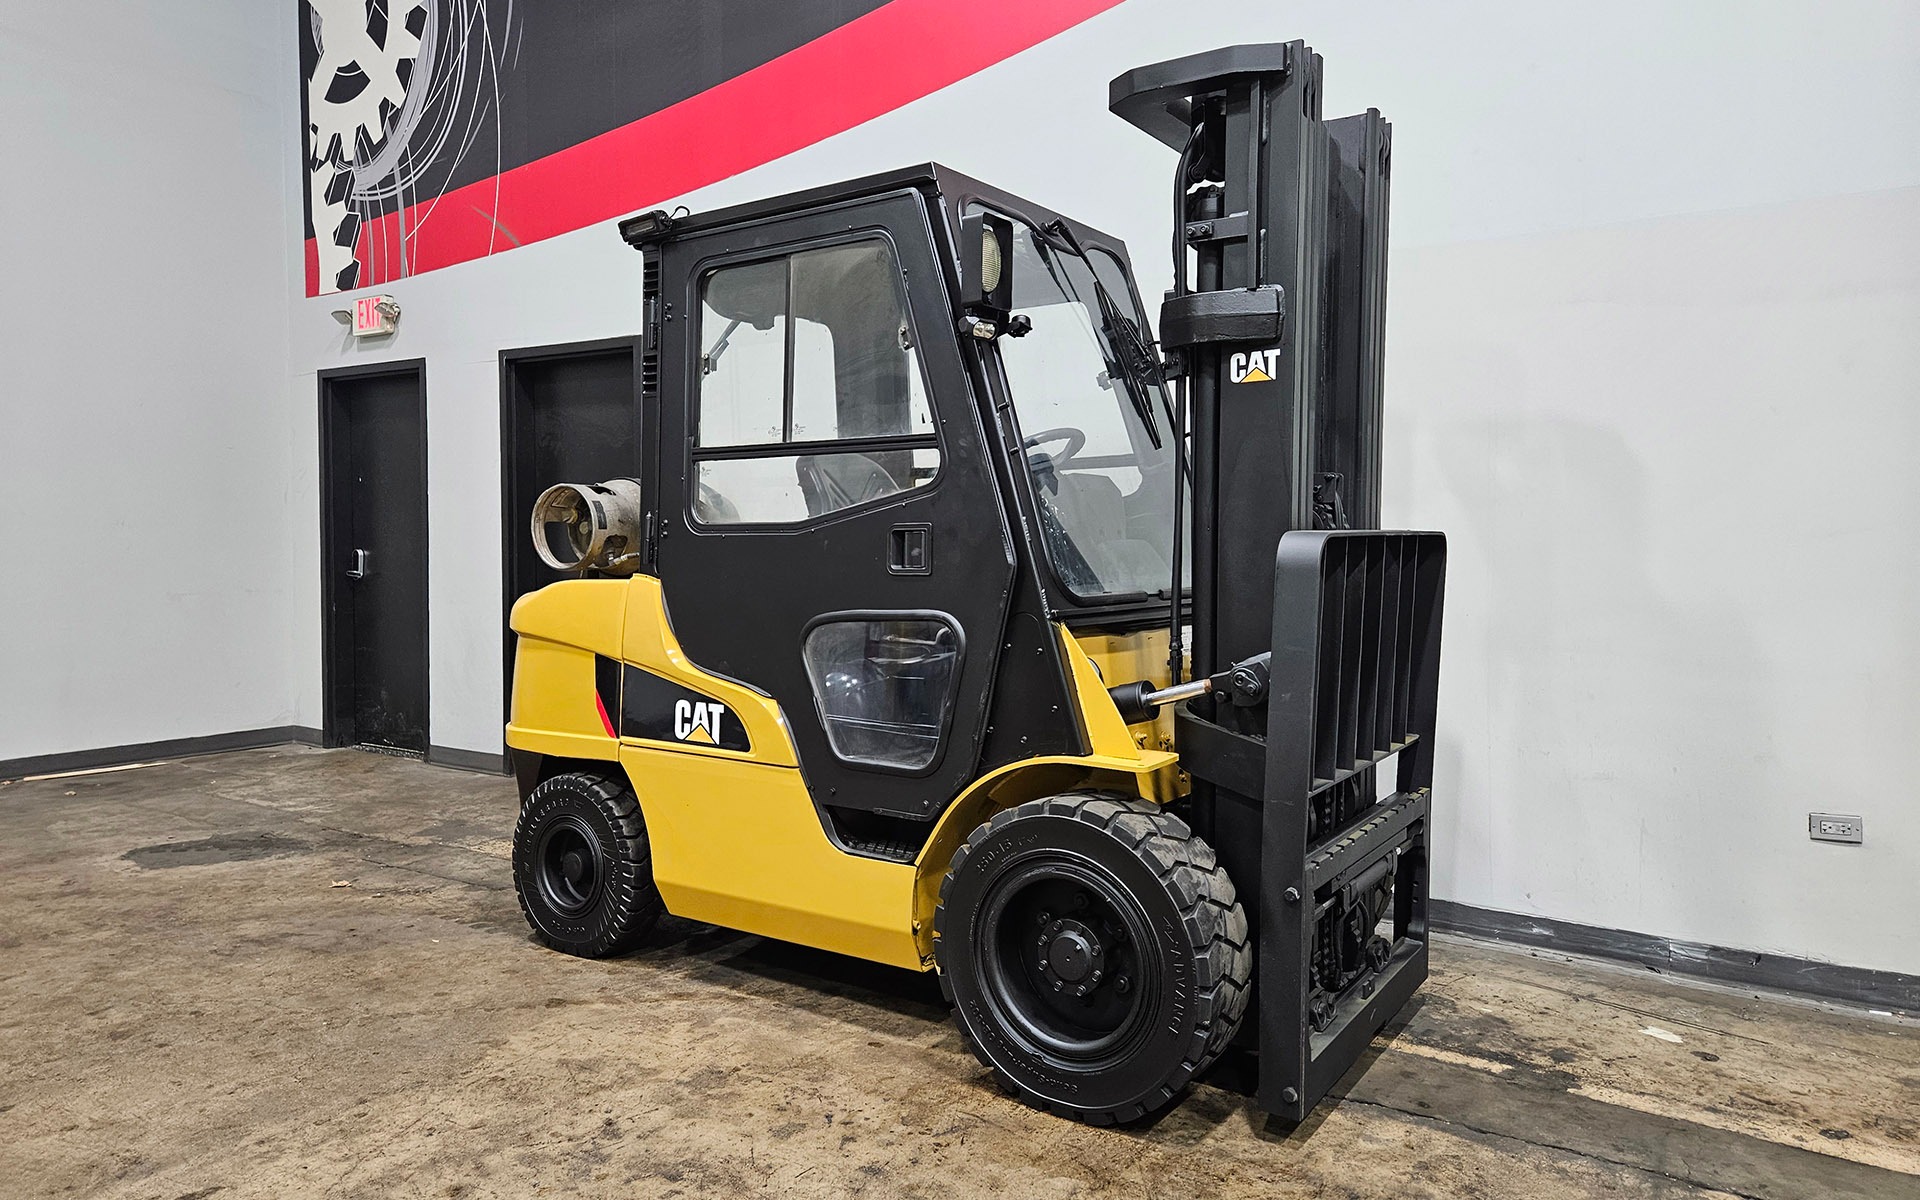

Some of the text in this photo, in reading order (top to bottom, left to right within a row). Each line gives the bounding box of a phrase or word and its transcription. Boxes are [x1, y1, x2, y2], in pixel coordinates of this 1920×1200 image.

[358, 297, 382, 330] EXIT
[1230, 349, 1281, 383] CAT
[674, 699, 725, 745] CAT
